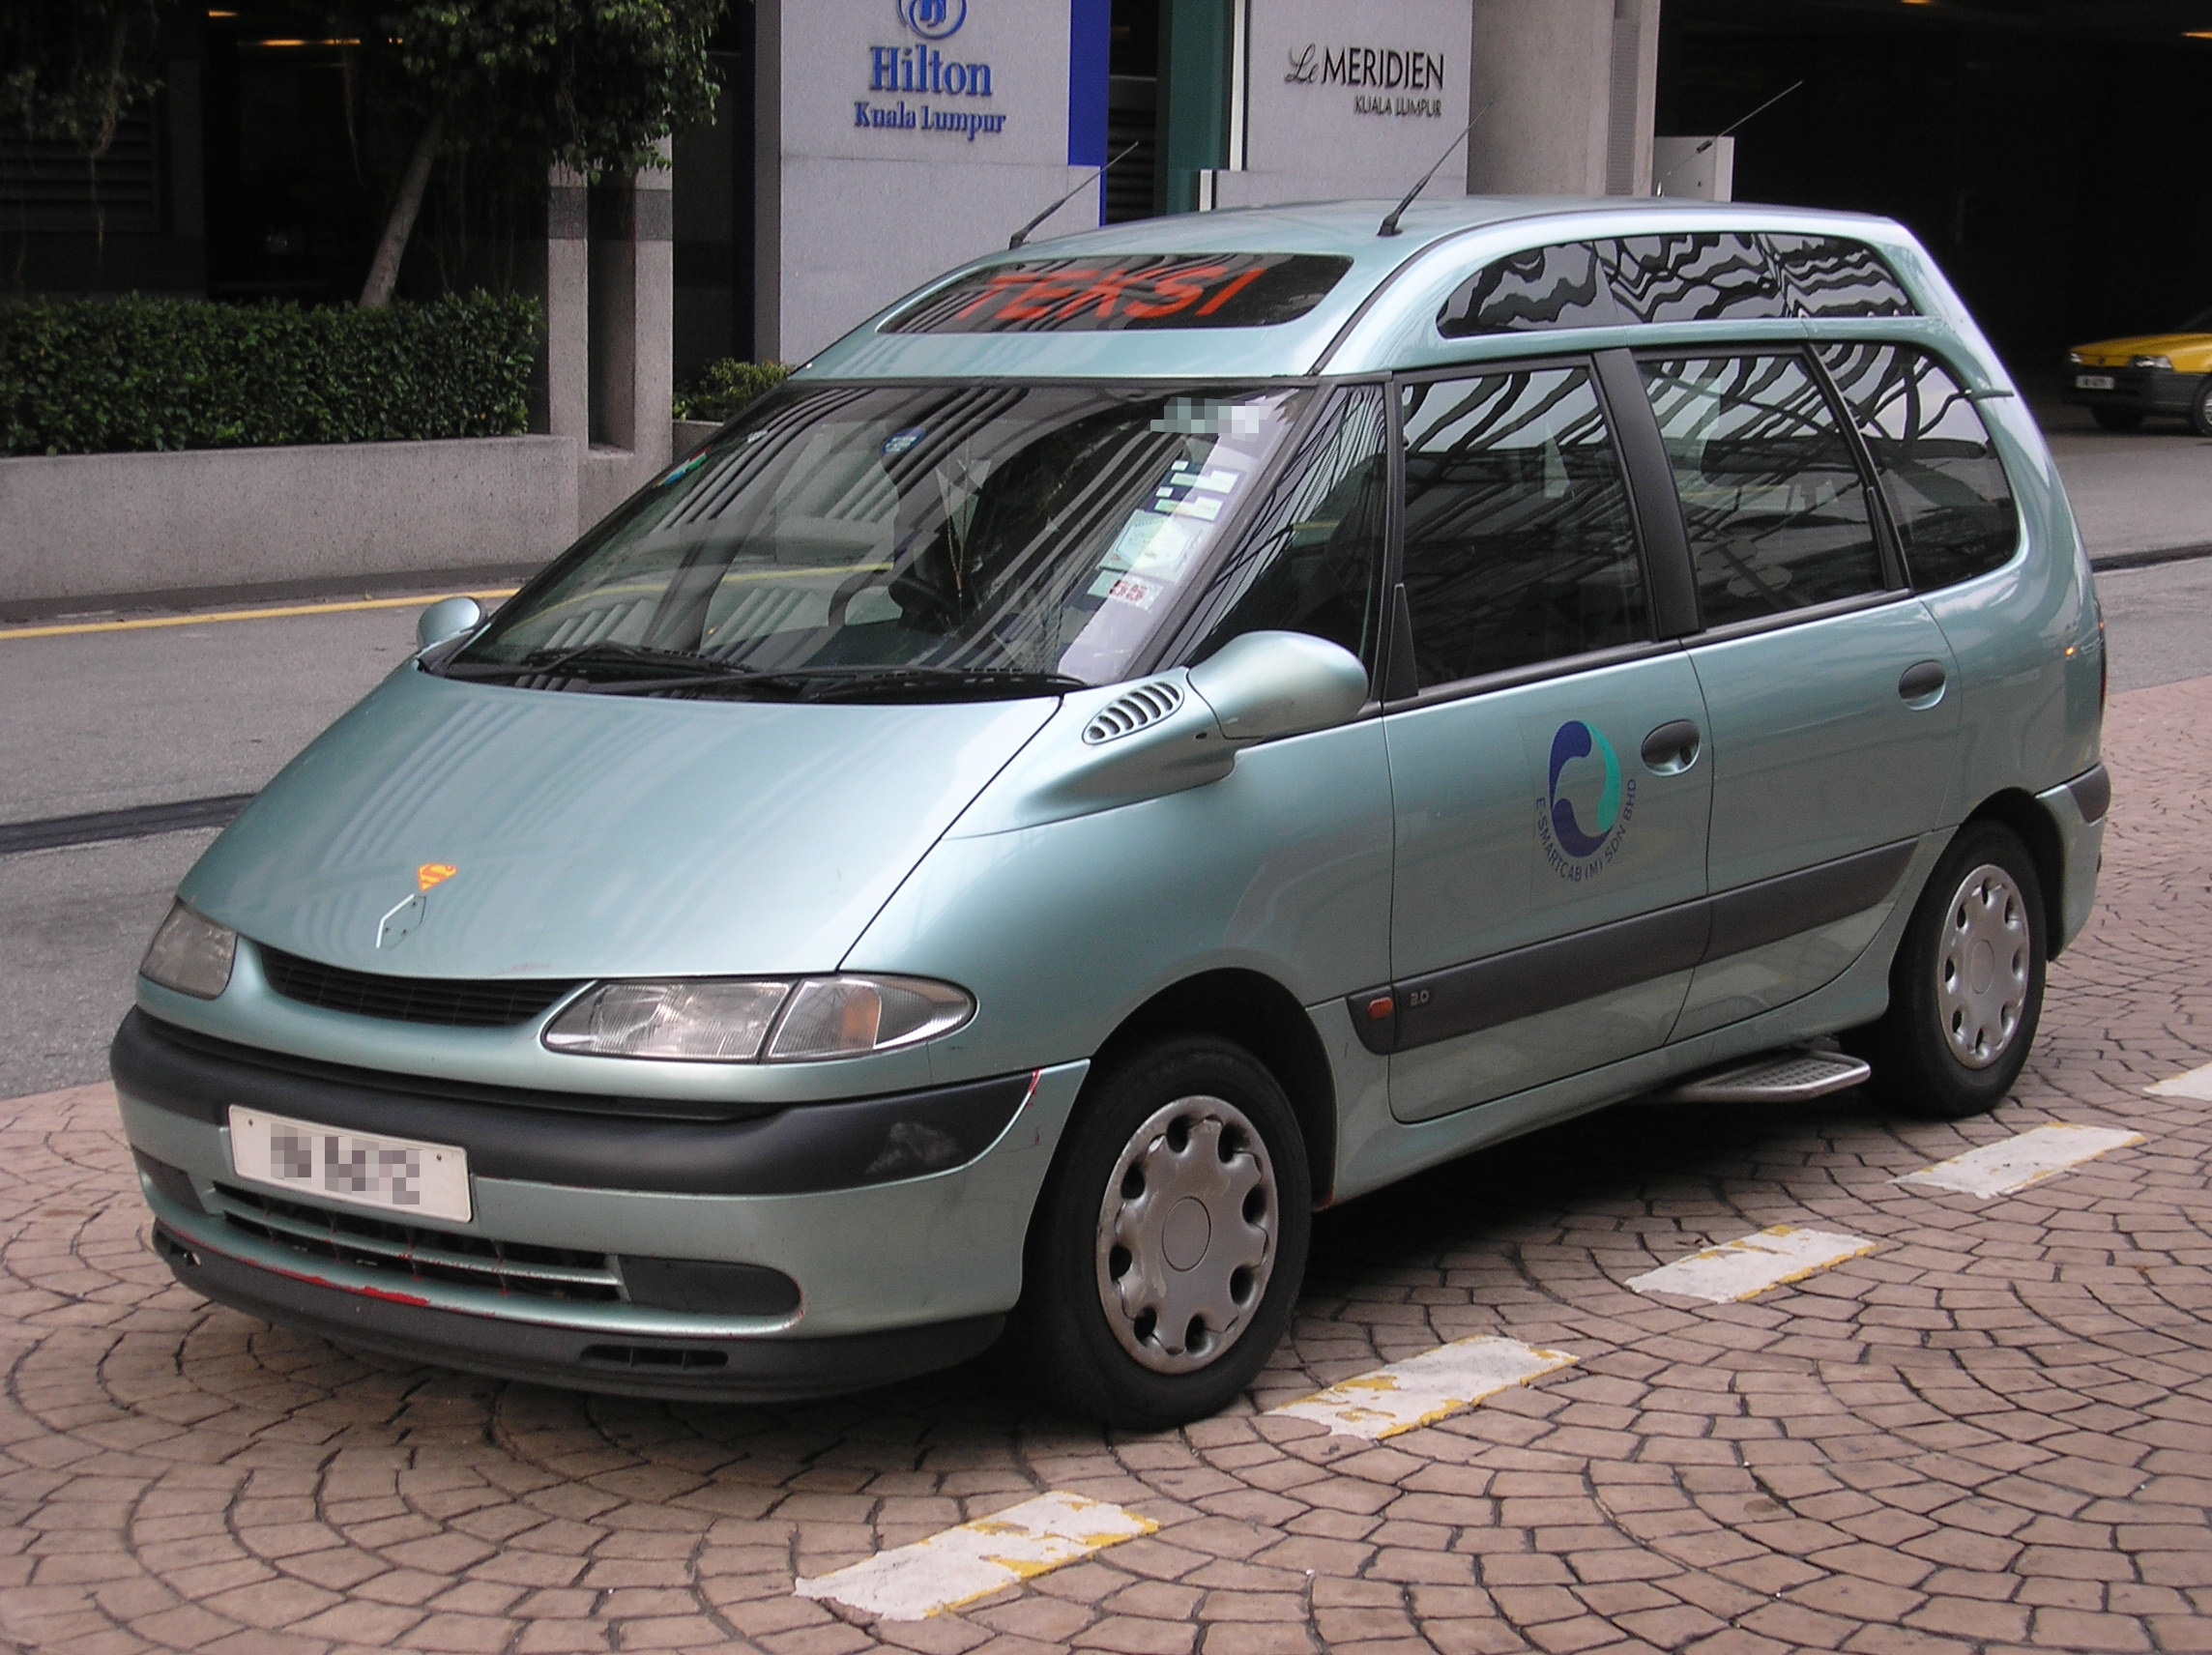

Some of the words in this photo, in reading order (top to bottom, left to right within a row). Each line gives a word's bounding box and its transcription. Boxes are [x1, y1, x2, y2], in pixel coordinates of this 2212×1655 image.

[869, 44, 992, 97] Hilton
[1285, 43, 1319, 83] Le
[1322, 46, 1444, 91] MERIDIEN
[854, 101, 917, 129] Kuala
[920, 105, 1006, 142] Lumpur
[1354, 95, 1392, 116] KUALA
[1395, 99, 1441, 117] LUMPUR
[956, 266, 1268, 320] TEKSI
[1606, 824, 1626, 863] SDN
